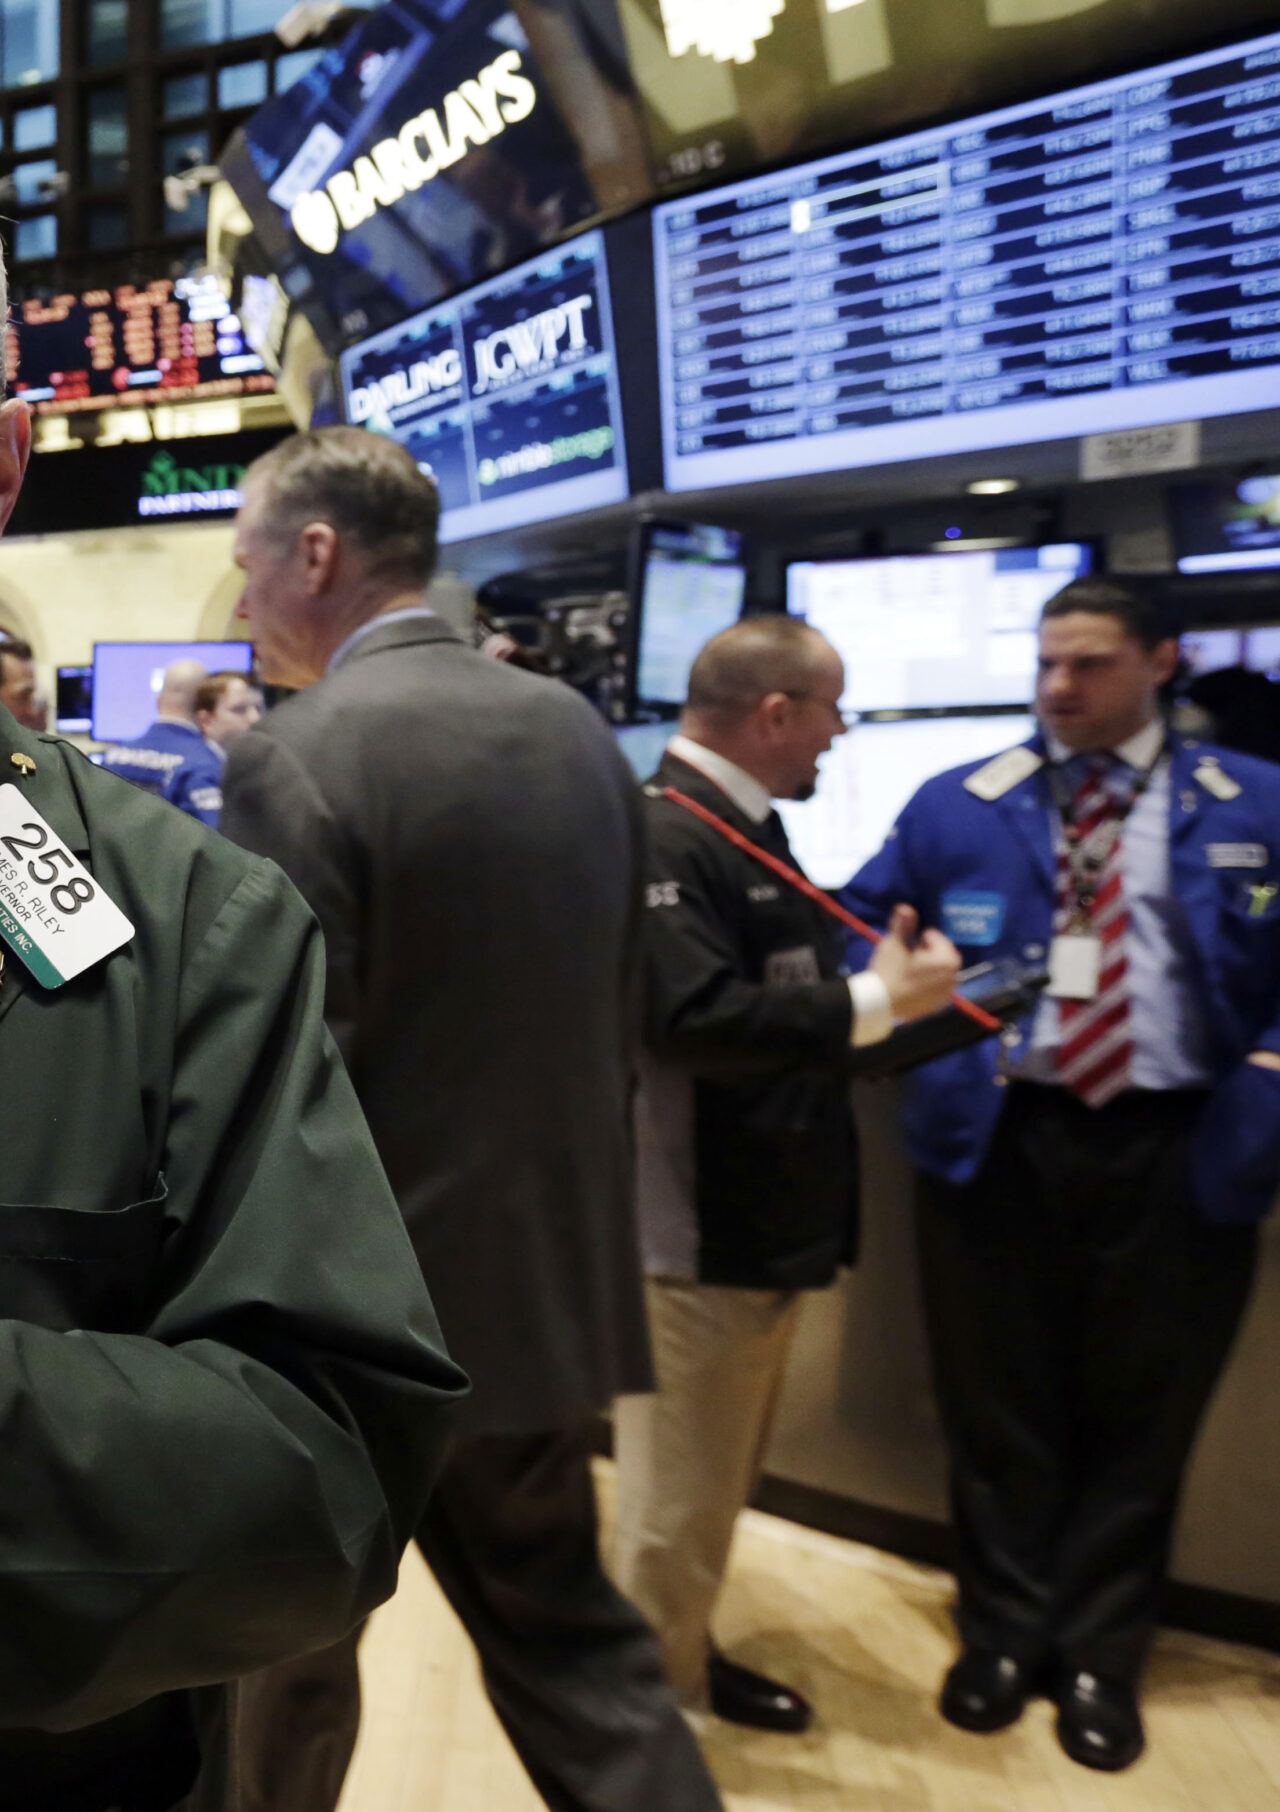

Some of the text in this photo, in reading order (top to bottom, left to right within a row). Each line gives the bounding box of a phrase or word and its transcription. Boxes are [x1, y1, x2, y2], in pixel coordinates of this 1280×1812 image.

[326, 49, 536, 230] BARCLAYS
[0, 823, 95, 915] 258
[14, 881, 29, 898] R.
[28, 897, 66, 935] RILEY
[14, 933, 34, 954] INC.
